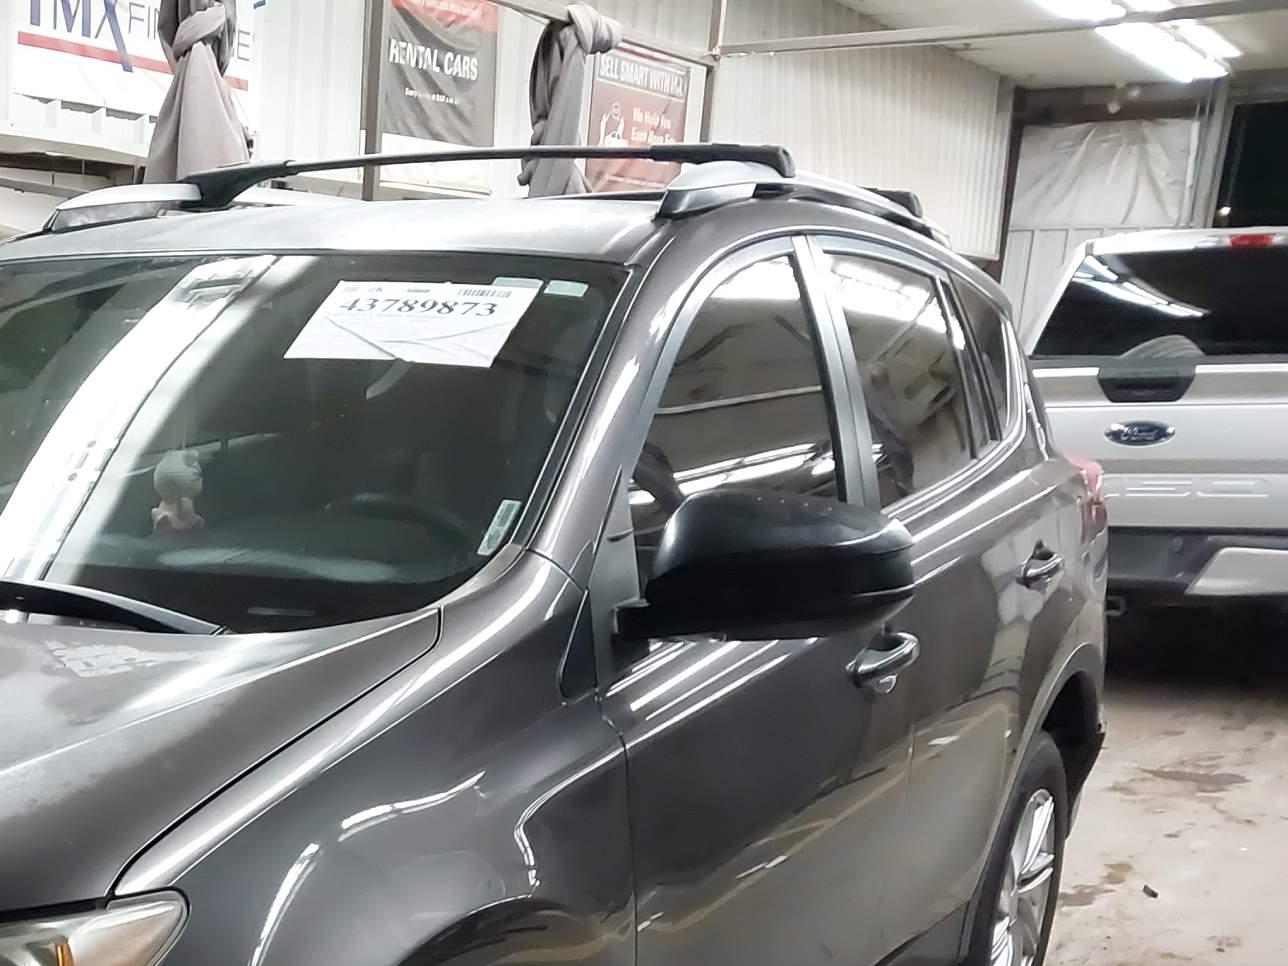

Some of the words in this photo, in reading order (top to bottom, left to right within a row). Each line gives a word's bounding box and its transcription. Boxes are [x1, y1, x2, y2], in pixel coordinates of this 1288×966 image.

[389, 38, 440, 73] RENTAL
[443, 51, 479, 81] CARS
[599, 55, 619, 79] SELL
[619, 60, 649, 88] SMART
[649, 68, 670, 94] WITH
[339, 297, 498, 317] 43789873
